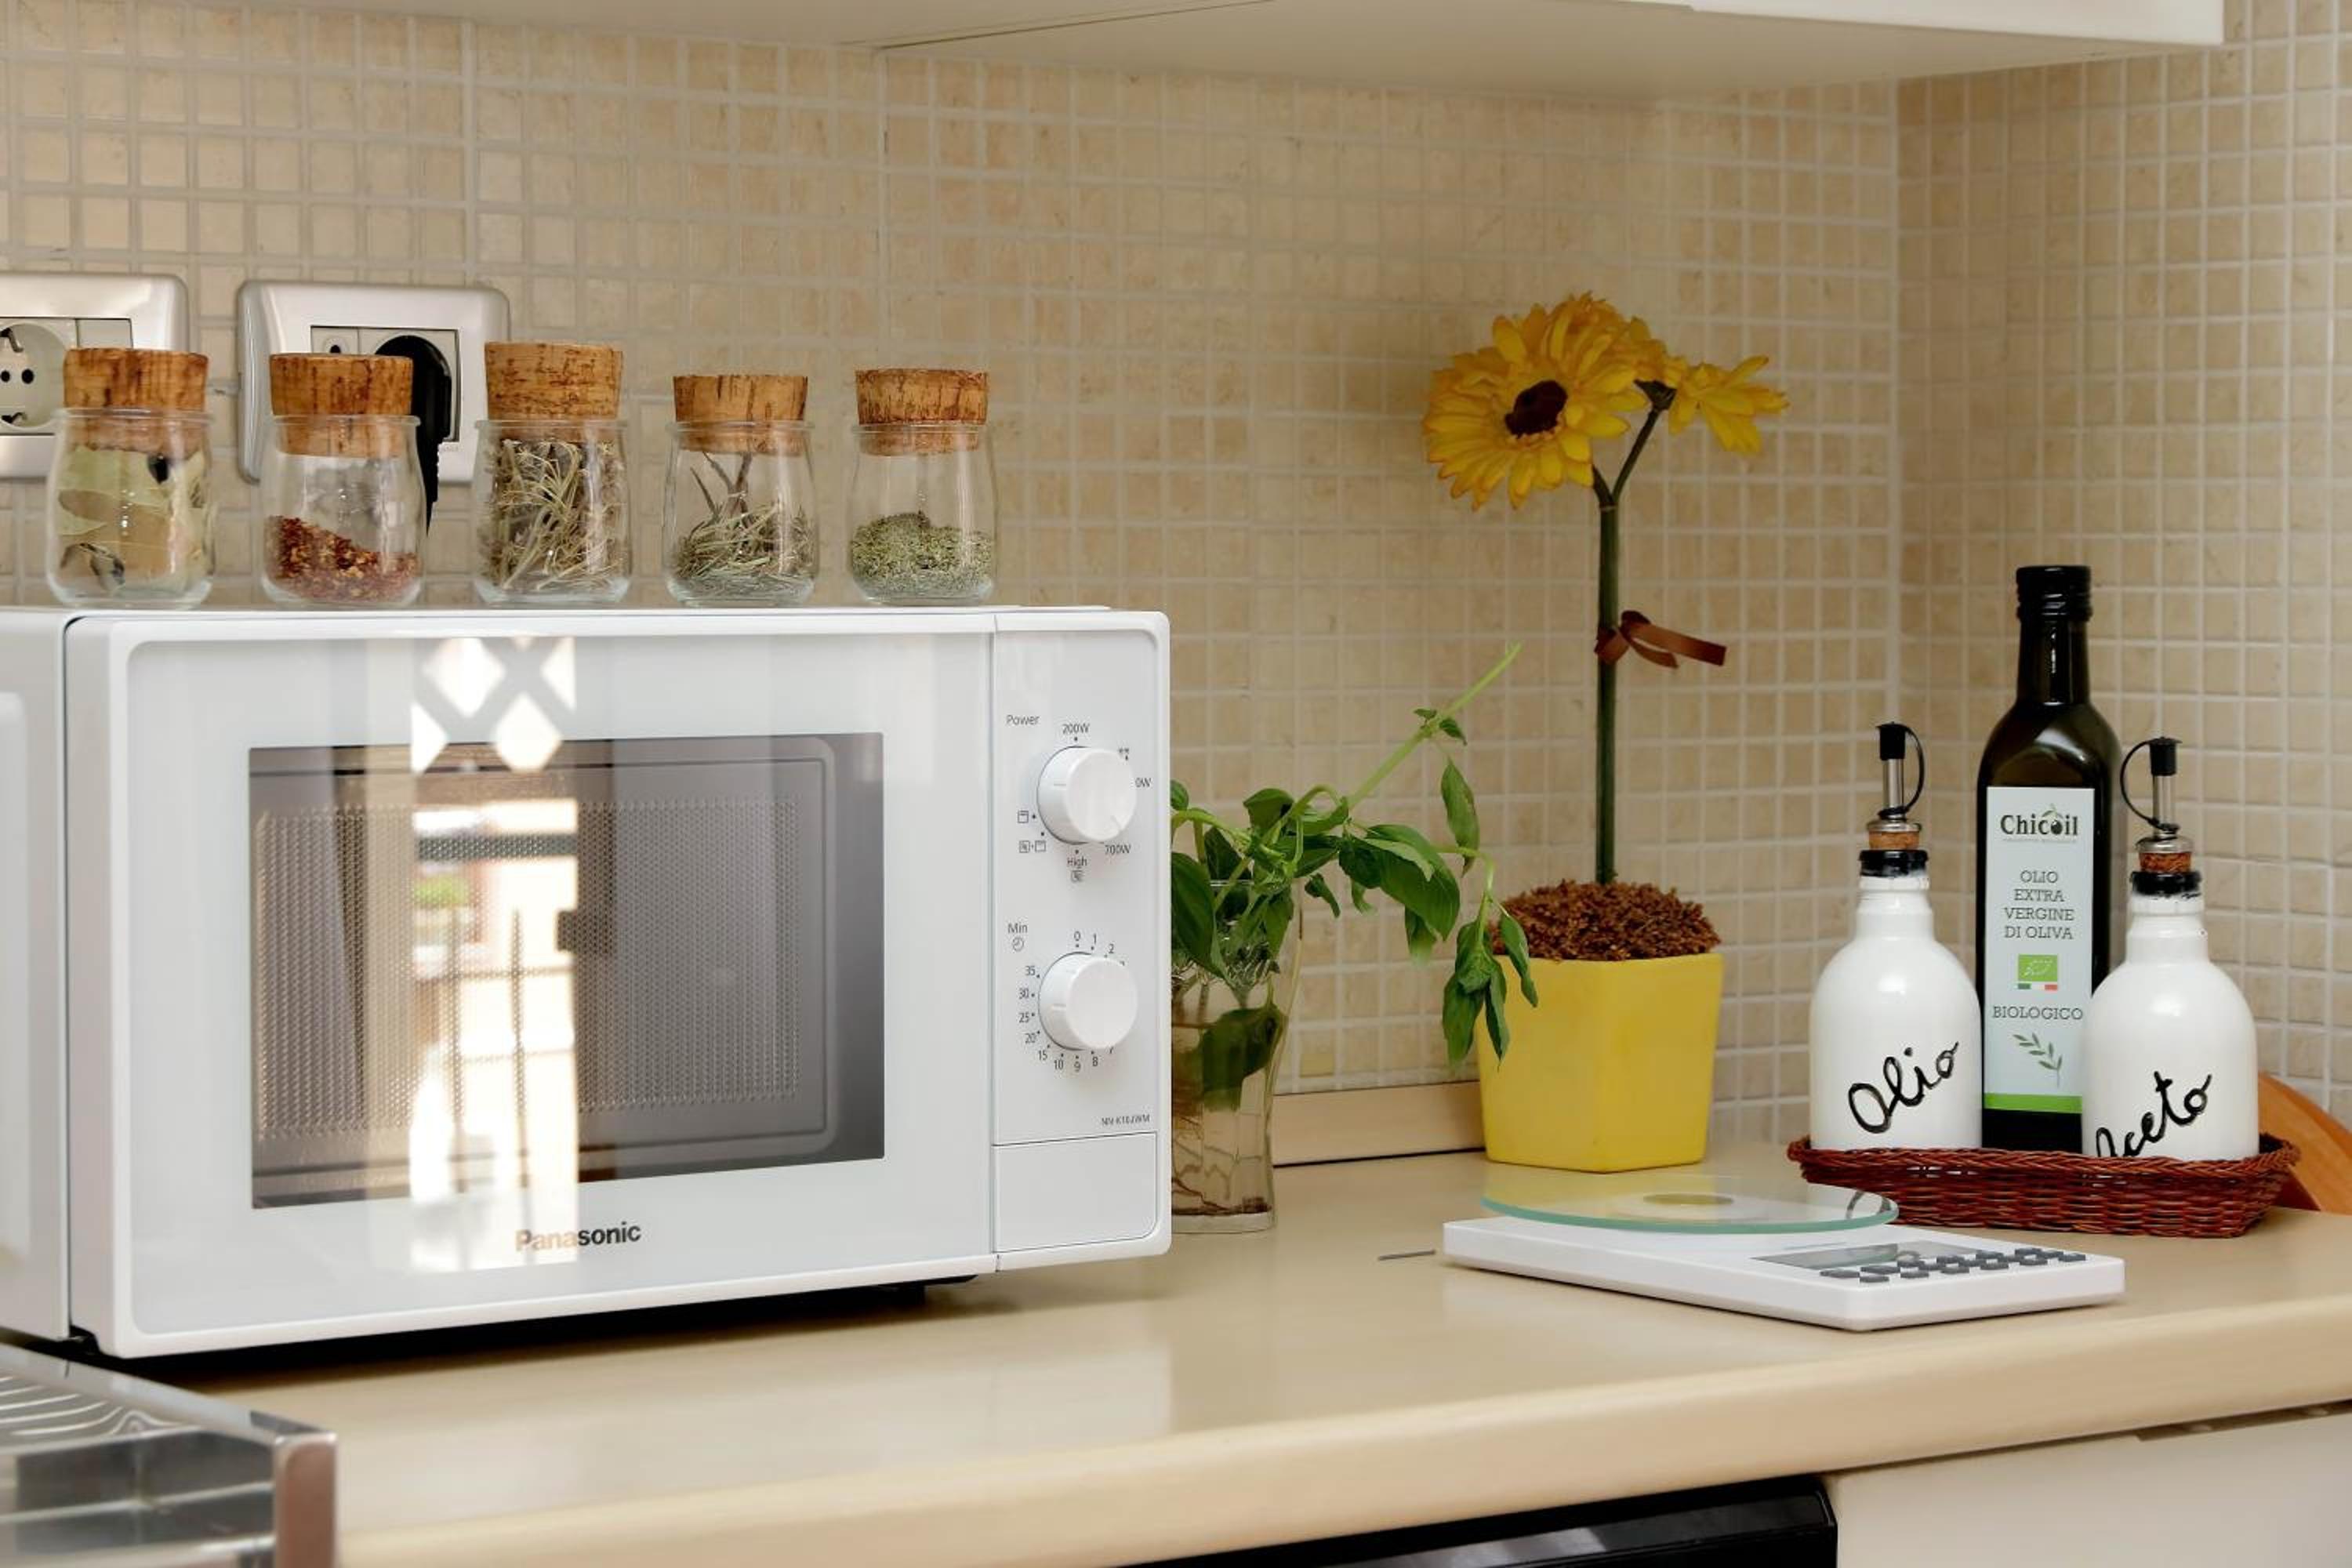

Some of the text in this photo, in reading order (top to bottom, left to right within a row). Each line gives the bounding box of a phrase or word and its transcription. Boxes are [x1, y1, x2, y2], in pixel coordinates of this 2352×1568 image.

[1006, 714, 1040, 726] Power
[1062, 723, 1090, 735] 200W
[2000, 812, 2079, 837] Chicoil
[1105, 844, 1131, 855] 700W
[1067, 855, 1087, 869] High
[2020, 869, 2059, 884] OLIO
[2013, 888, 2065, 902] EXTRA
[2003, 907, 2074, 921] VERGINE
[1007, 921, 1029, 934] Min
[2004, 925, 2074, 940] DI OLIVA
[1073, 931, 1081, 942] 0
[1108, 943, 1115, 954] 2
[1025, 965, 1036, 977] 35
[1018, 988, 1029, 1000] 30
[1018, 1012, 1029, 1023] 25
[1992, 1005, 2084, 1021] BIOLOGICO
[1024, 1033, 1036, 1044] 20
[1038, 1049, 1048, 1061] 15
[1053, 1058, 1064, 1070] 10
[1073, 1061, 1081, 1073] 9
[1091, 1056, 1099, 1067] 8
[1847, 1041, 1959, 1134] Olio
[515, 1221, 641, 1251] Panasonic
